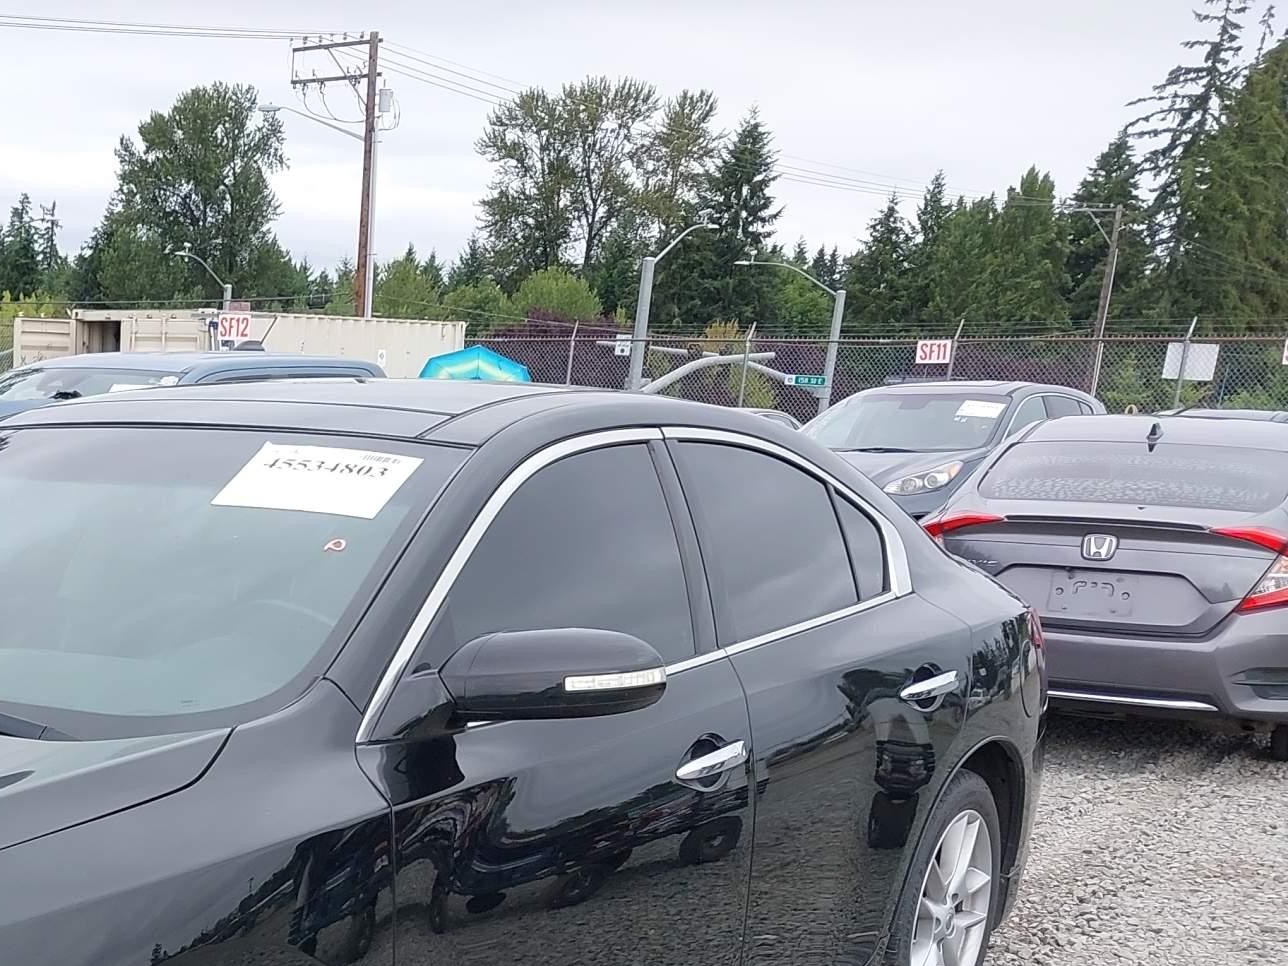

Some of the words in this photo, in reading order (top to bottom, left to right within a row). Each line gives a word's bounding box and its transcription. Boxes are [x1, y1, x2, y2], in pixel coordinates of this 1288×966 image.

[219, 317, 249, 337] SF12
[919, 342, 948, 361] SF11
[263, 457, 389, 478] 45534803
